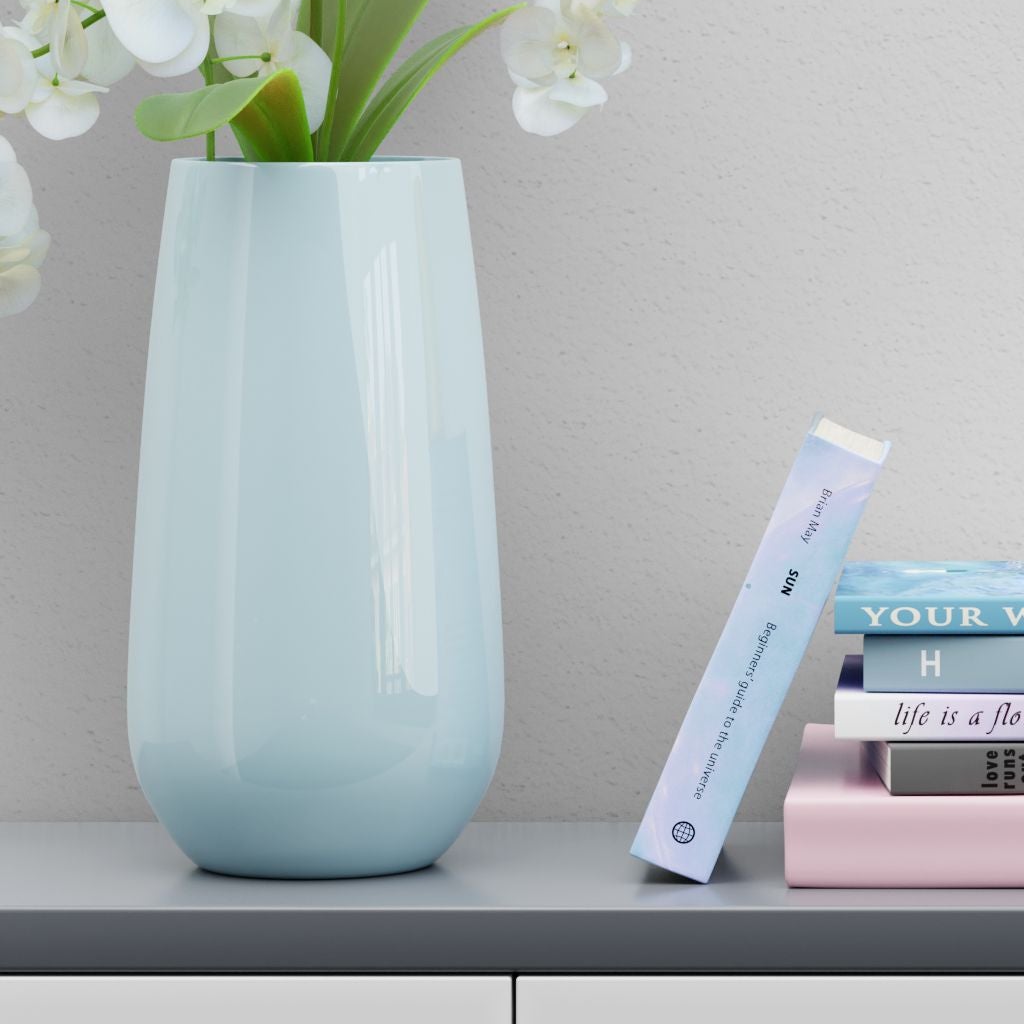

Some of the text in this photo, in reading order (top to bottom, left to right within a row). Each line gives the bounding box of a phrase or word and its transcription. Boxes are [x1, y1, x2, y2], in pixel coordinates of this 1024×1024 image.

[800, 488, 833, 545] Brian May
[781, 568, 799, 596] SUN
[861, 606, 989, 627] YOUR
[729, 680, 750, 715] guide
[723, 715, 735, 729] to
[893, 702, 930, 734] life
[940, 705, 959, 726] is
[968, 710, 984, 726] a
[713, 731, 729, 750] the
[693, 752, 719, 801] universe
[981, 750, 999, 789] love
[1003, 748, 1017, 790] runs
